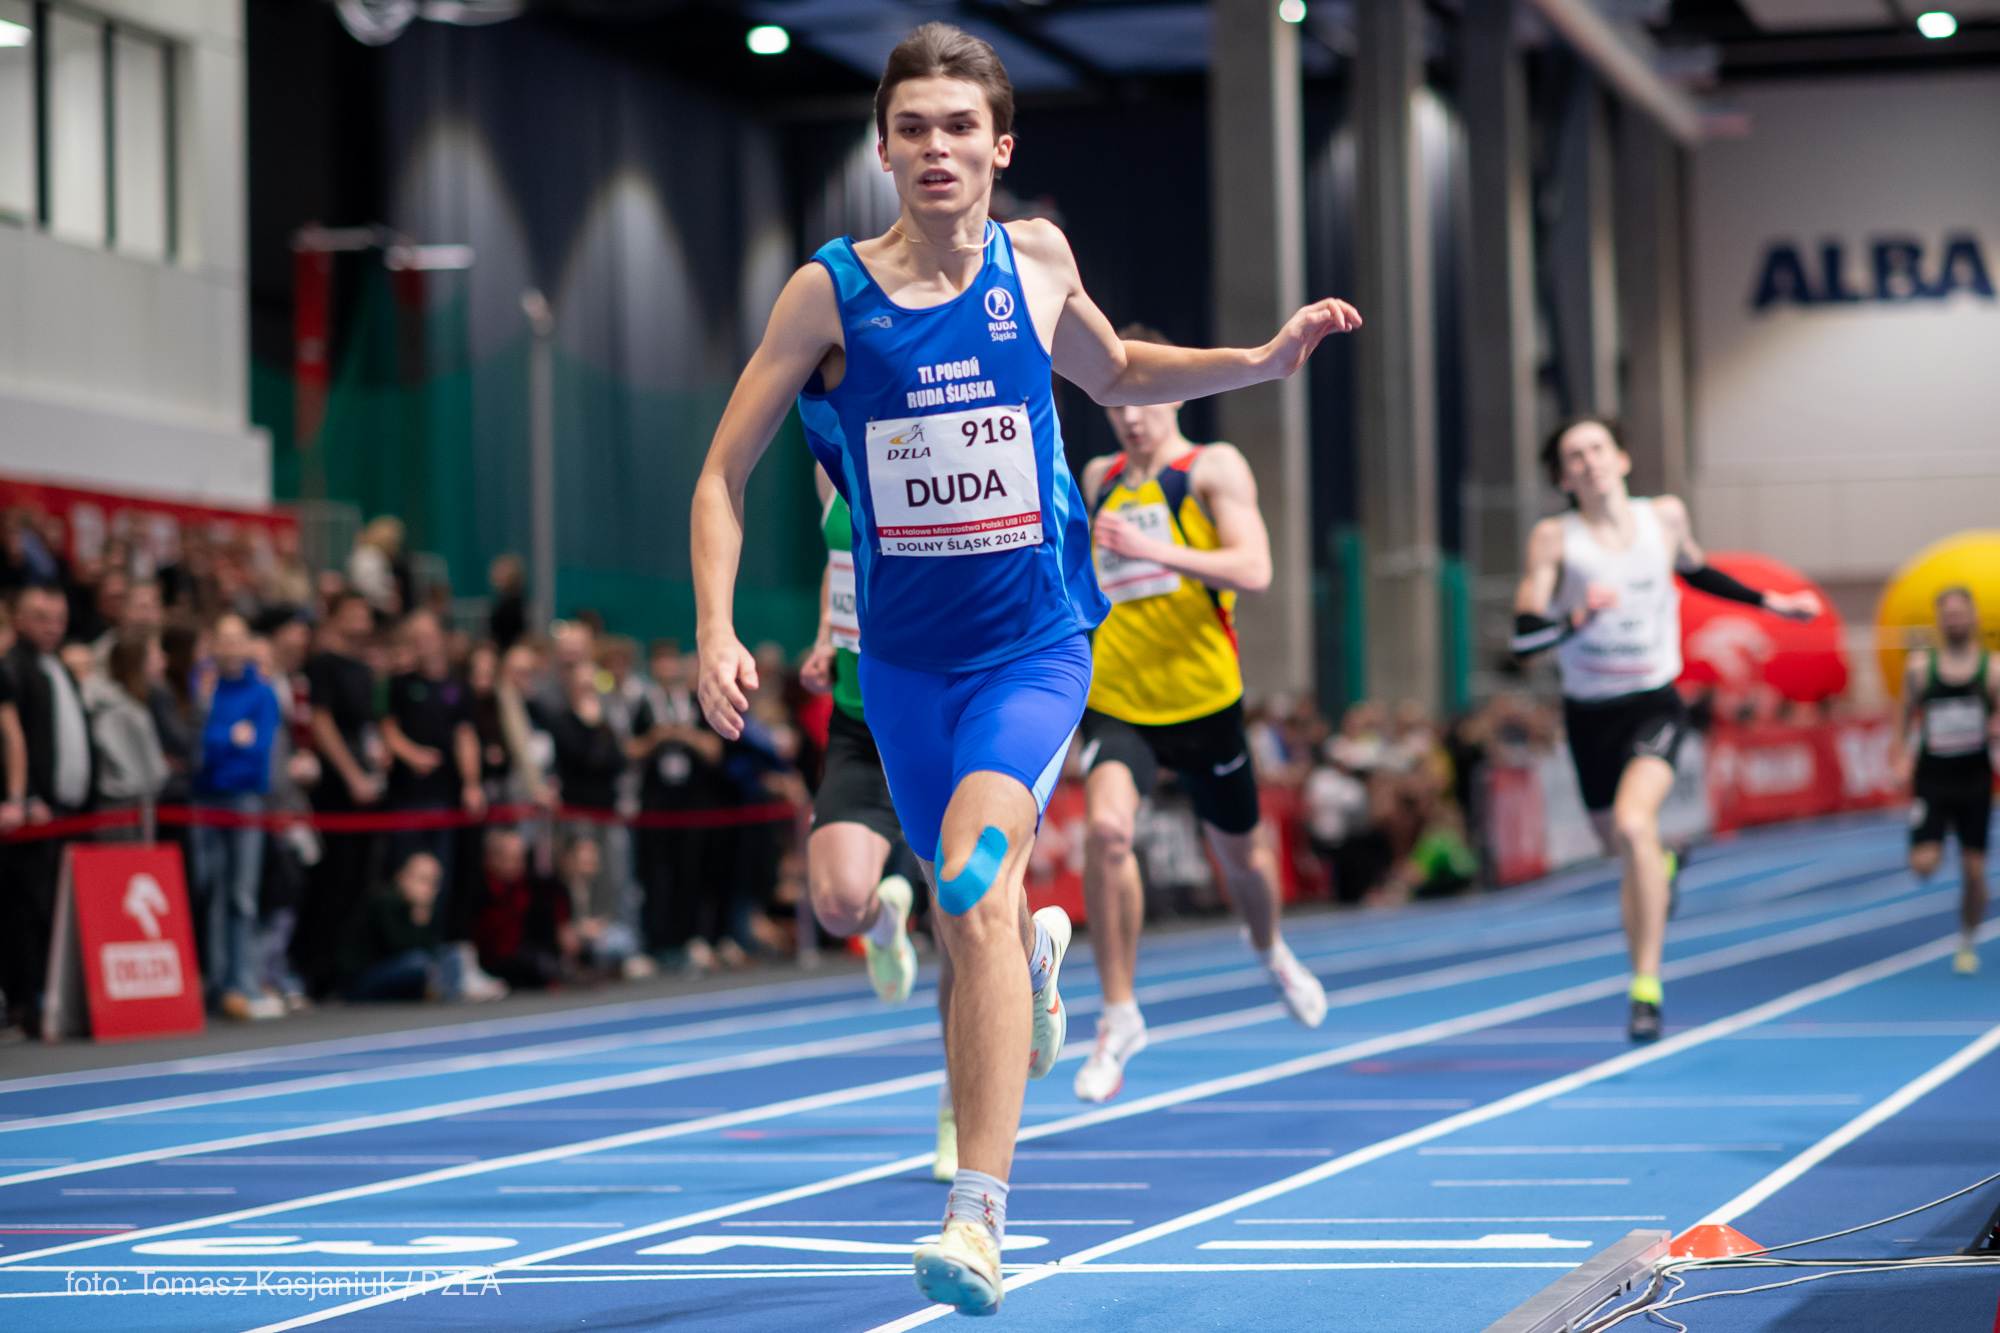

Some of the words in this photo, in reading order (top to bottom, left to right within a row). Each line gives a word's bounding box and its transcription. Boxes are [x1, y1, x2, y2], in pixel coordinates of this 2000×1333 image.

[1752, 237, 1996, 308] ALBA
[988, 320, 1018, 332] RUDA
[990, 330, 1017, 342] Śląska
[917, 366, 934, 384] TL
[935, 356, 980, 382] POGOŃ
[907, 388, 945, 408] RUDA
[945, 380, 996, 403] ŚLĄSKA
[961, 416, 1017, 447] 918
[887, 447, 931, 460] DZLA
[905, 469, 1008, 508] DUDA
[902, 528, 932, 536] Halowe
[932, 524, 980, 534] Mistrzostwa
[981, 520, 1005, 530] Polski
[1005, 517, 1018, 526] U18
[1022, 514, 1037, 523] U20
[896, 541, 943, 552] DOLNY
[947, 537, 992, 552] ŚLĄSK
[995, 530, 1027, 546] 2024
